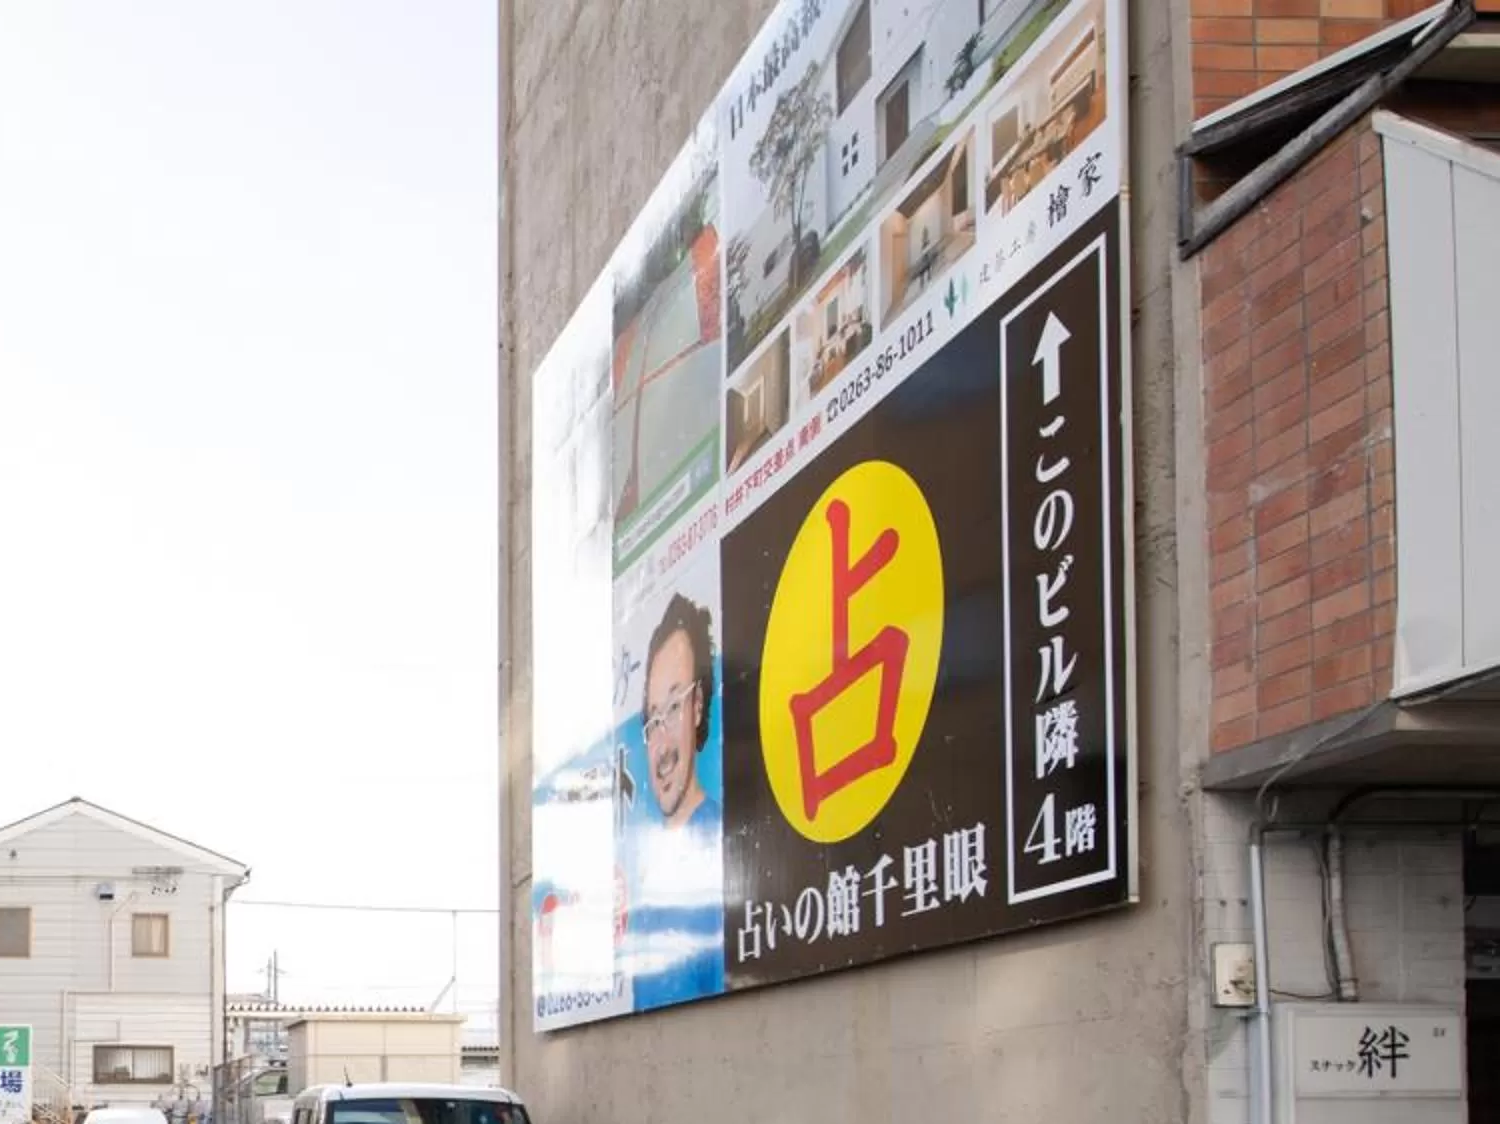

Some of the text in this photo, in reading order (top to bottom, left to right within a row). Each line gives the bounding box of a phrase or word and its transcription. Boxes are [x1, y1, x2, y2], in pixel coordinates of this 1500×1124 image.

[839, 308, 935, 412] 0263-86-1011
[1033, 415, 1080, 779] このビル隣
[790, 498, 910, 822] 占
[1023, 793, 1097, 866] 4階
[737, 821, 989, 963] 占いの館千里眼
[1357, 1025, 1411, 1079] 絆
